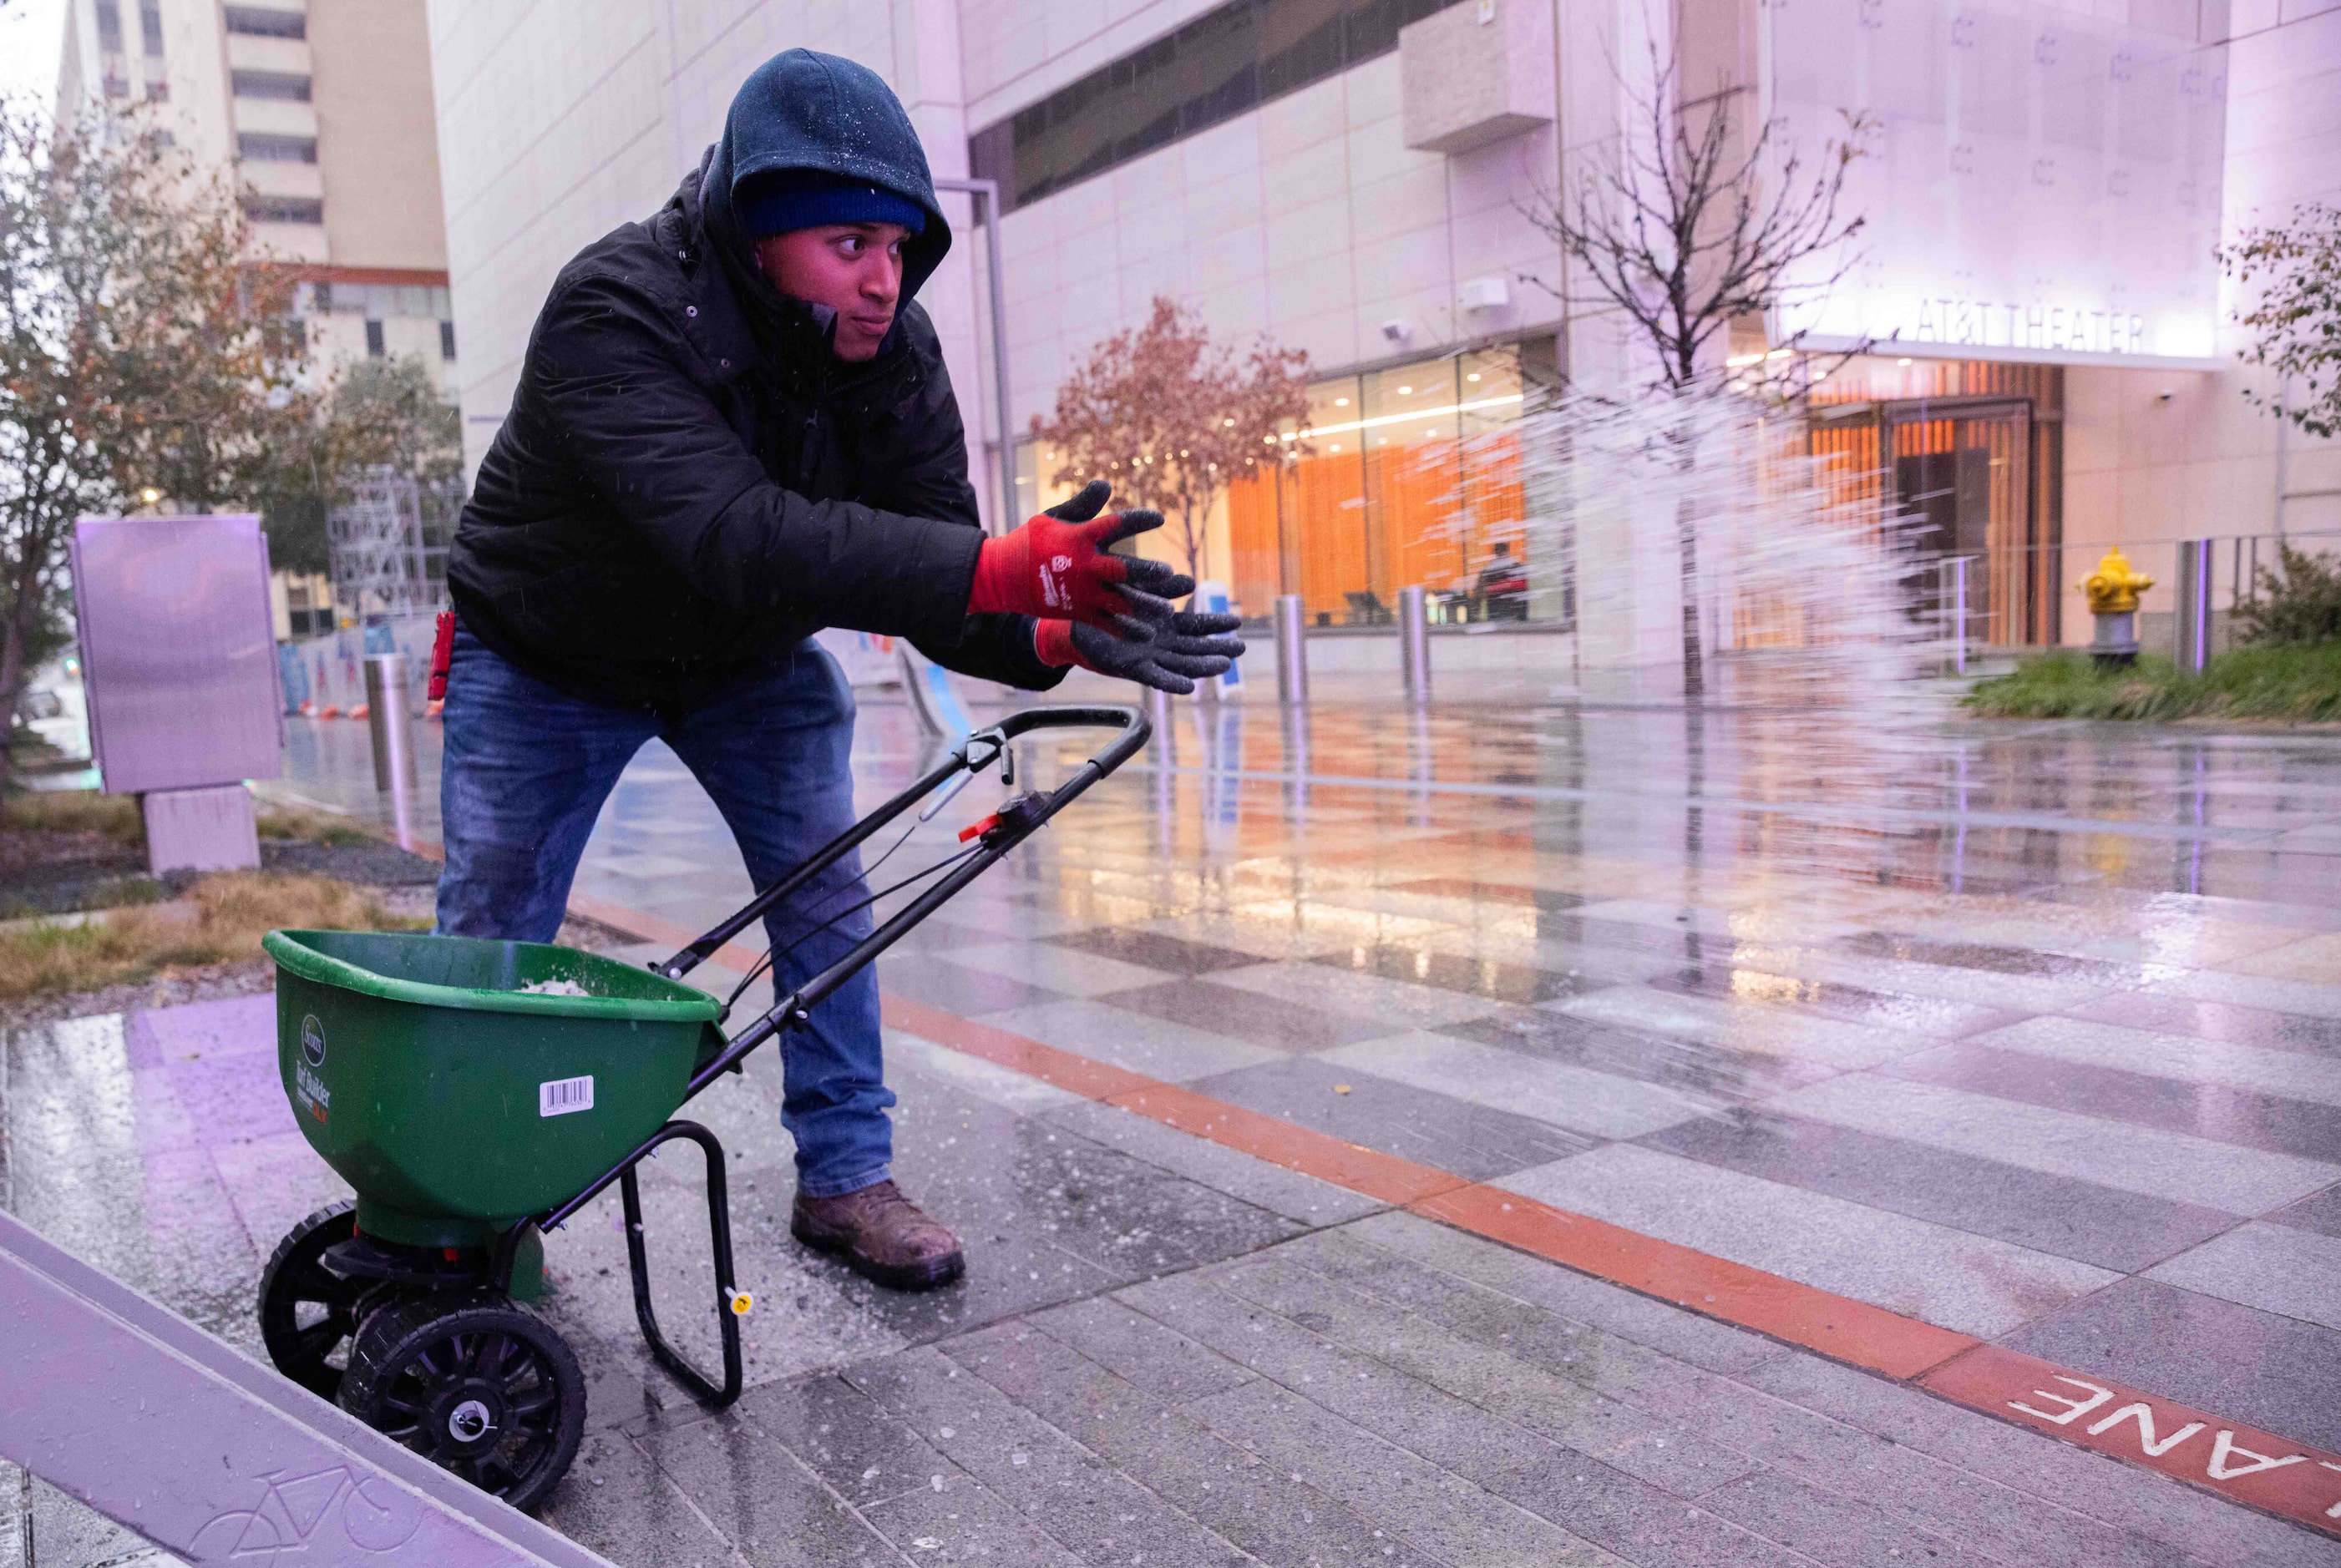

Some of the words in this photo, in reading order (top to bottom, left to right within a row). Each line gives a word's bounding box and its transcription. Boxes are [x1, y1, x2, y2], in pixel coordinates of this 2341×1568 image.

[1916, 298, 1994, 345] AT&T
[2004, 304, 2144, 354] THEATER
[305, 1024, 322, 1054] Scotts
[306, 1071, 330, 1108] Builder
[2006, 1374, 2341, 1518] ANE
